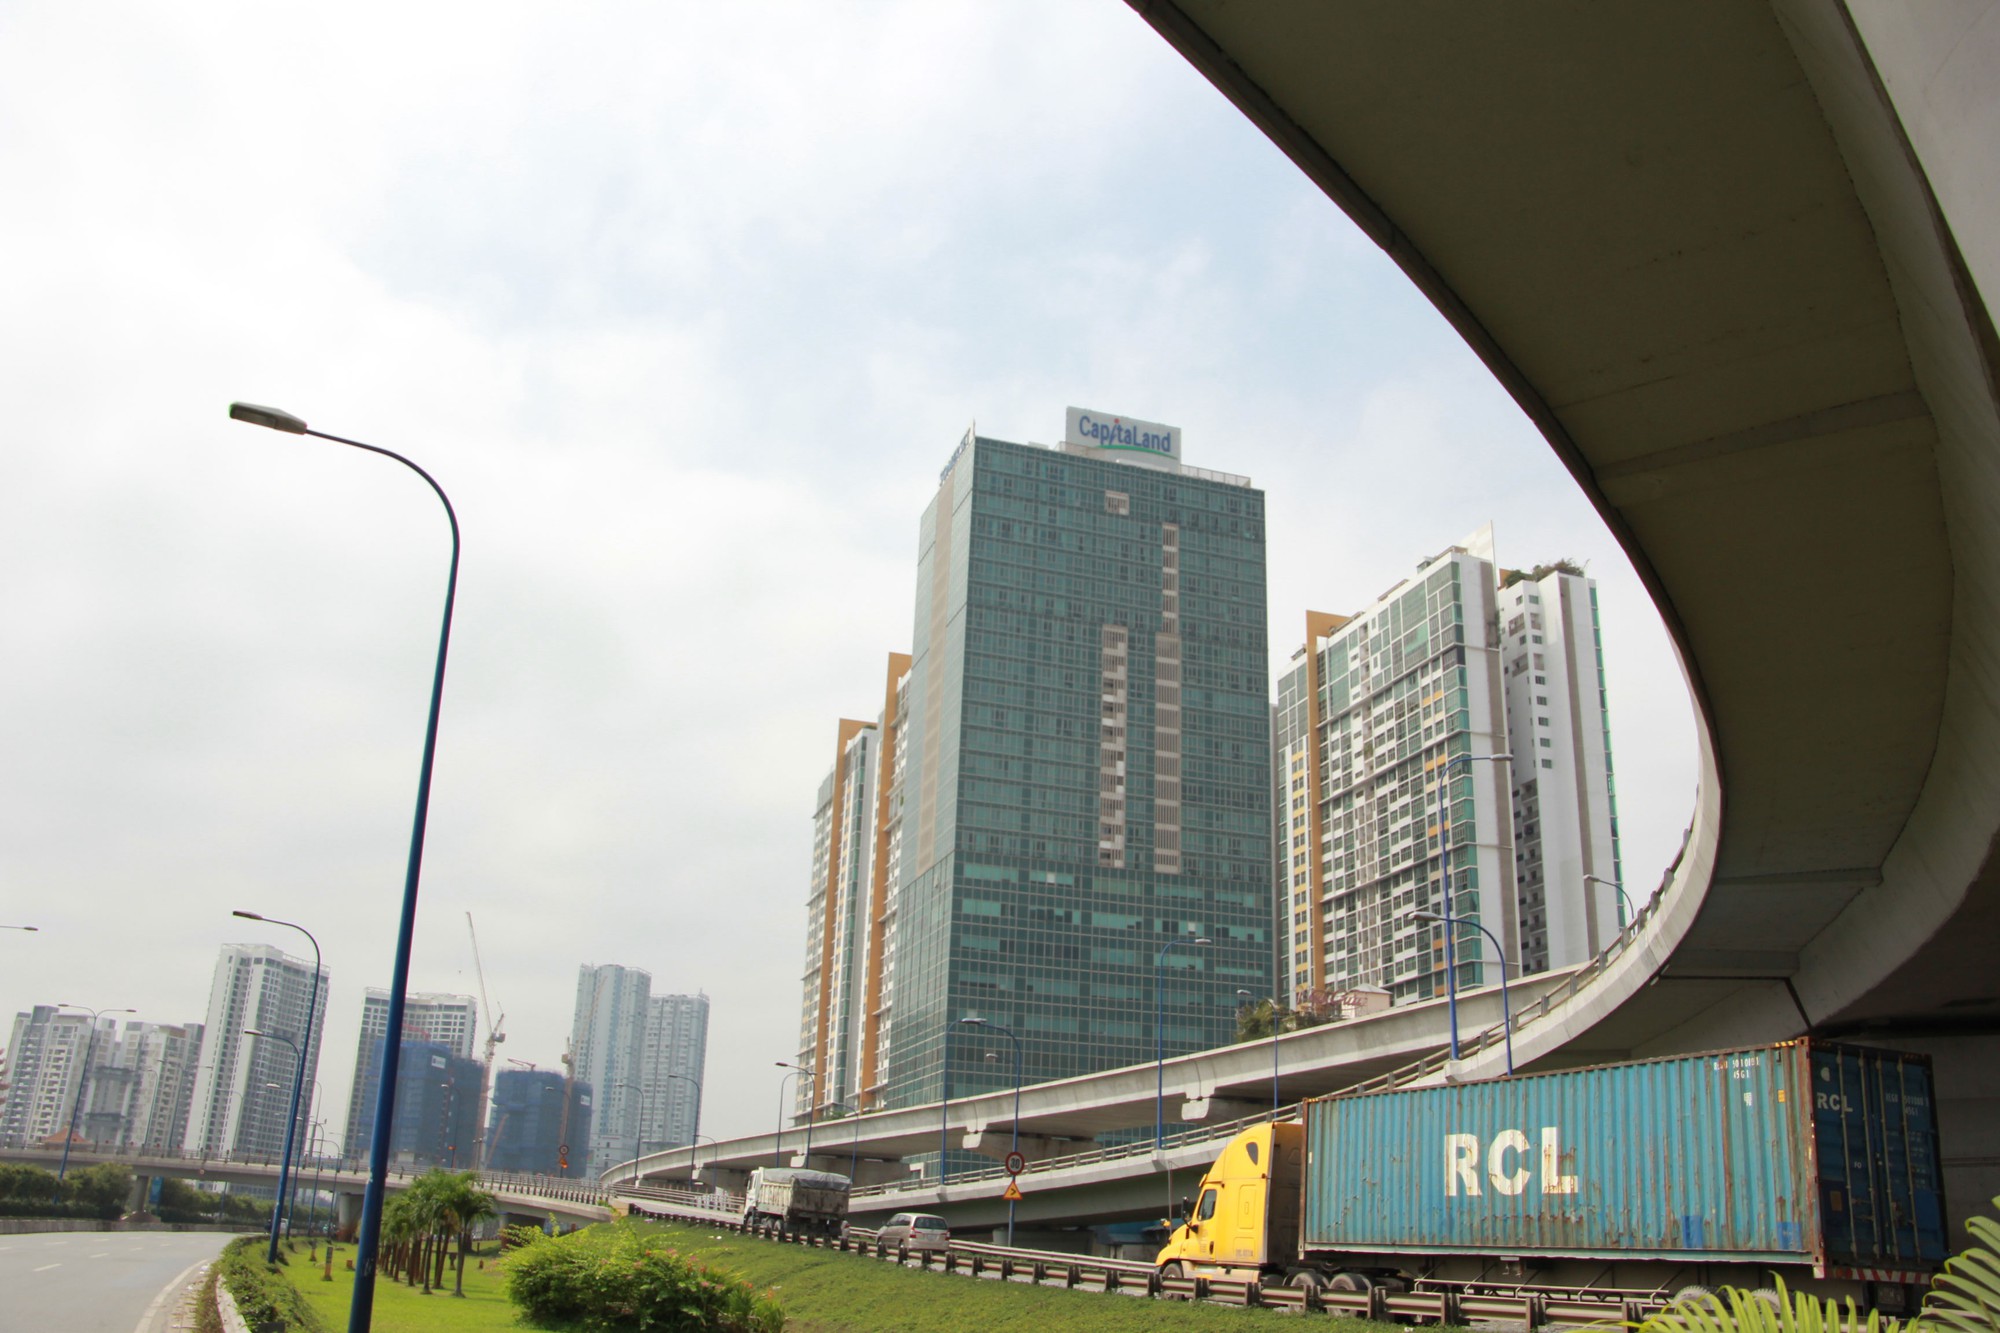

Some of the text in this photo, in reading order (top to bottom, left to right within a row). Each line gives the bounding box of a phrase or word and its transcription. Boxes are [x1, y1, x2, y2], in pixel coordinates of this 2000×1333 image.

[1079, 415, 1171, 452] CapitaLand
[1816, 1091, 1853, 1112] RCL
[1010, 1157, 1021, 1169] 30
[1444, 1127, 1579, 1196] RCL
